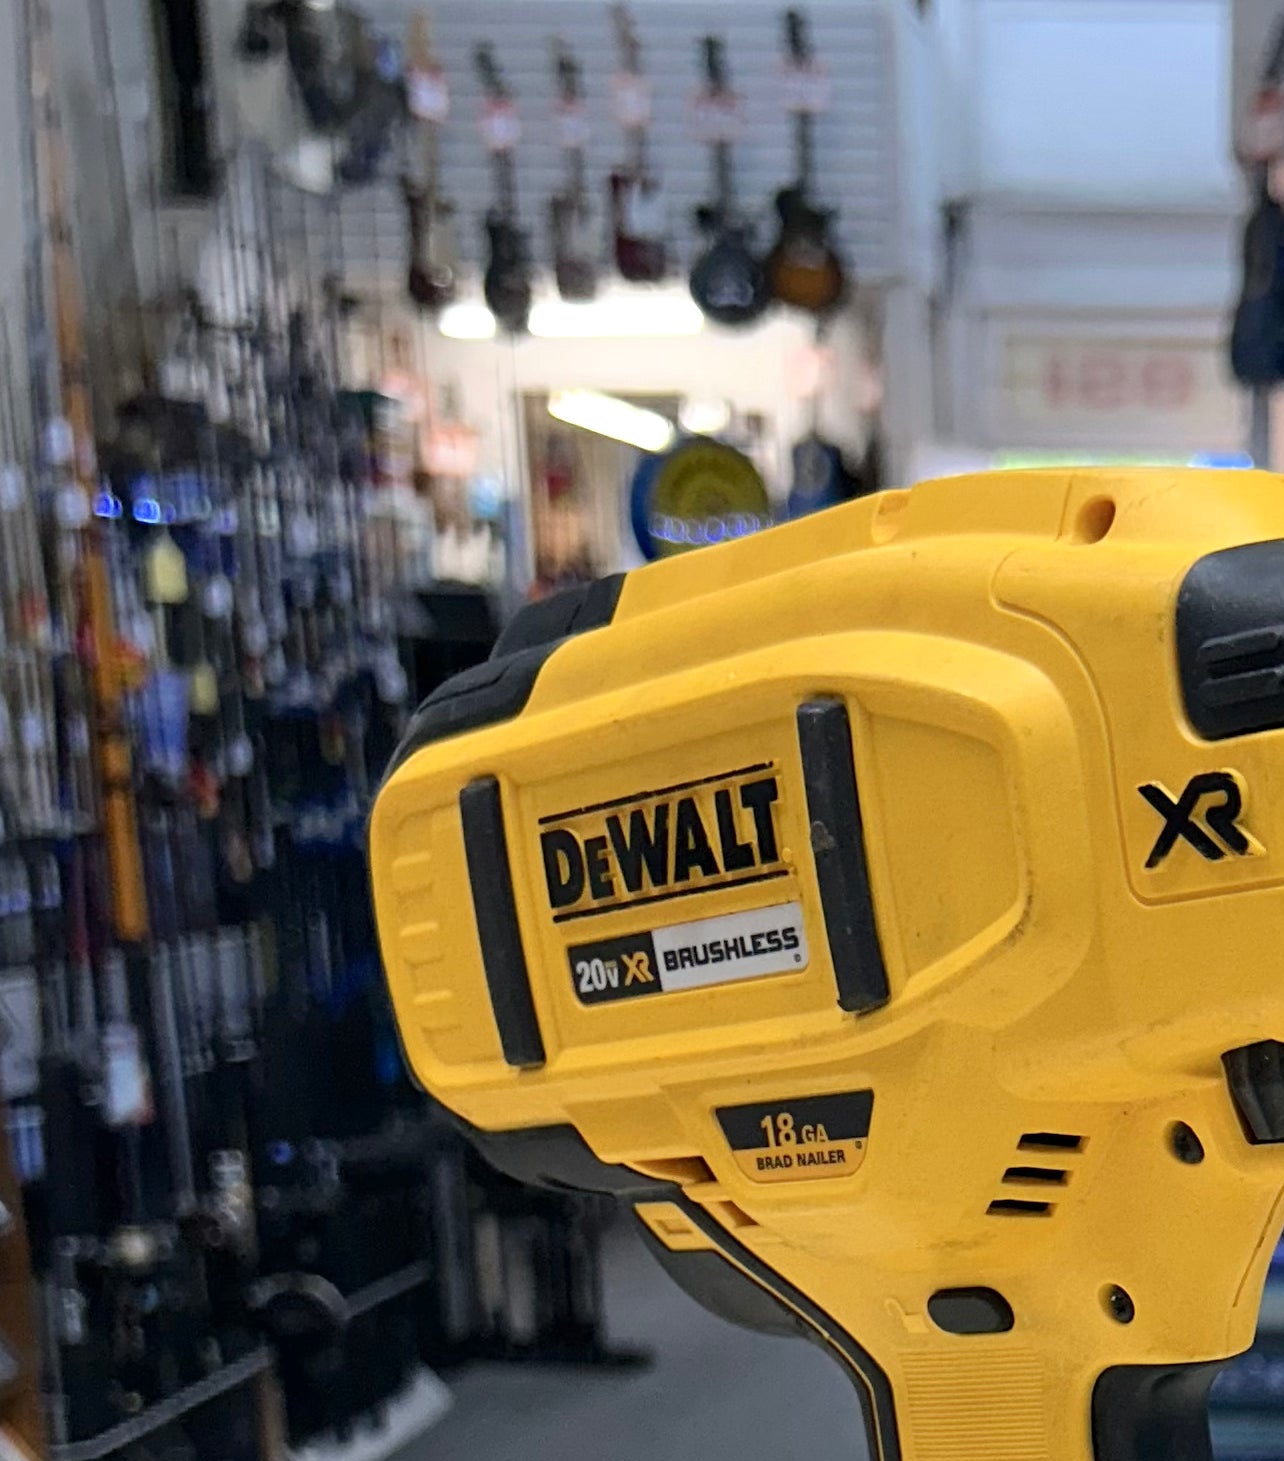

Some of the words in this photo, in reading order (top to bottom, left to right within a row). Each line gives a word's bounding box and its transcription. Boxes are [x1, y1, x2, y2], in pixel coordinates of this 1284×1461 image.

[1137, 771, 1255, 871] XR
[620, 950, 655, 987] XR
[663, 926, 799, 972] BRUSHLESS
[760, 1112, 797, 1148] 18
[801, 1123, 830, 1144] GA
[756, 1155, 793, 1171] BRAD
[797, 1150, 846, 1167] NAILER
